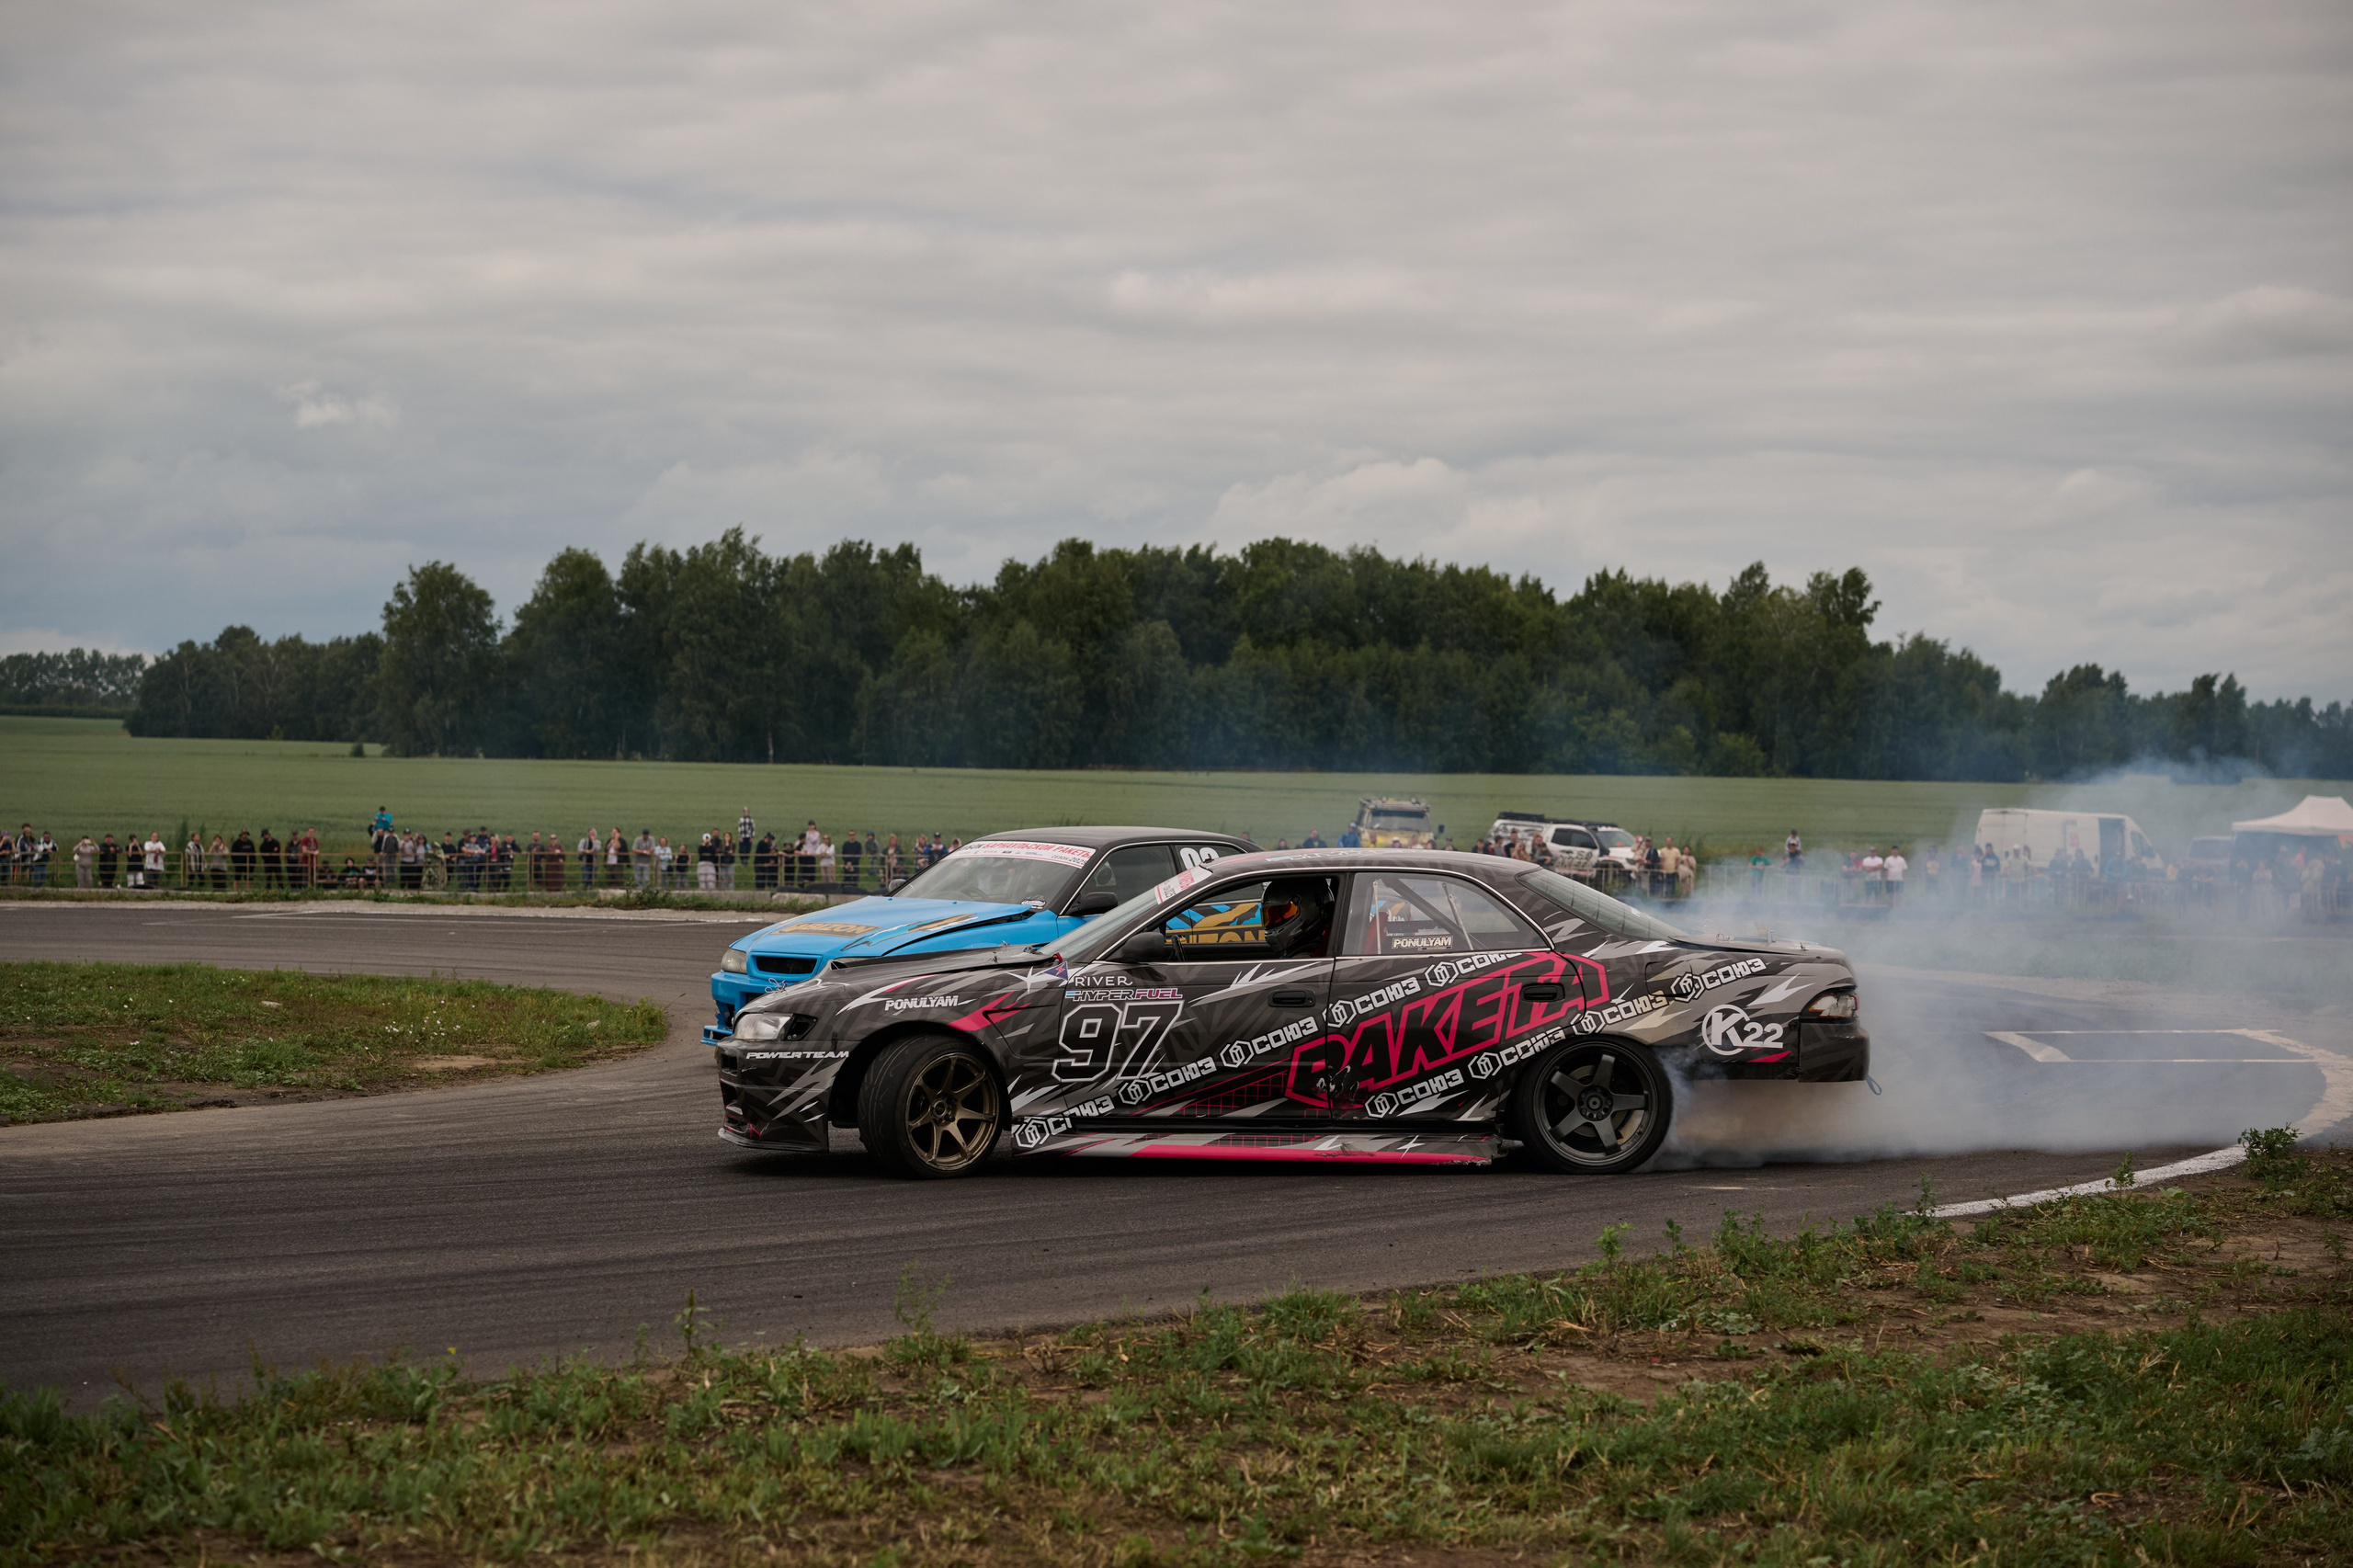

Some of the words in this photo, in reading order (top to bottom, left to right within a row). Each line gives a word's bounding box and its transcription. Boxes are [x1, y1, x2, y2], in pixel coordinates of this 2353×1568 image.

[1393, 937, 1452, 949] PONULYAM
[1074, 976, 1133, 987] RIVER
[1700, 957, 1768, 992] СОЮЗ
[884, 995, 959, 1011] PONULYAM
[1355, 976, 1421, 1015] СОЮЗ
[1601, 990, 1668, 1027] СОЮЗ
[1051, 1000, 1185, 1083] 97
[1251, 1017, 1319, 1054] СОЮЗ
[1150, 1056, 1218, 1094] СОЮЗ
[1396, 1068, 1464, 1106] СОЮЗ
